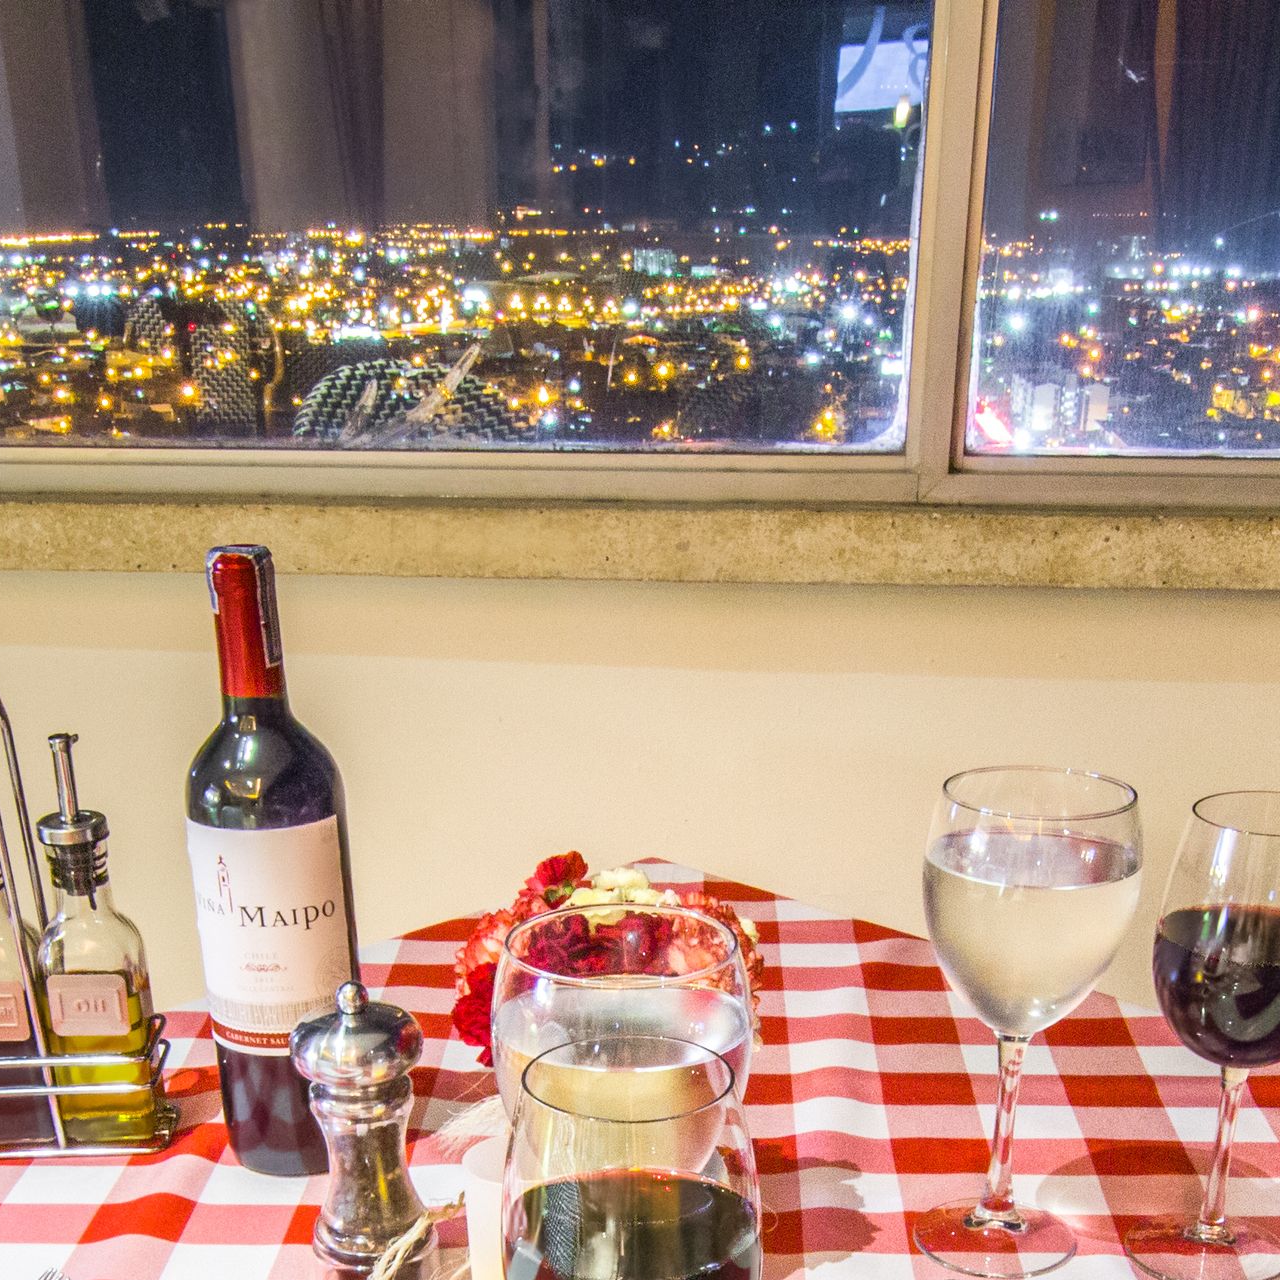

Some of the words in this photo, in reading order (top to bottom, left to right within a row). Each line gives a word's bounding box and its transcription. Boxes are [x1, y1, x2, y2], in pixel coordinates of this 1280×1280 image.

[77, 998, 107, 1013] Oil
[225, 1030, 270, 1045] CABERNET
[270, 1037, 291, 1045] SAU
